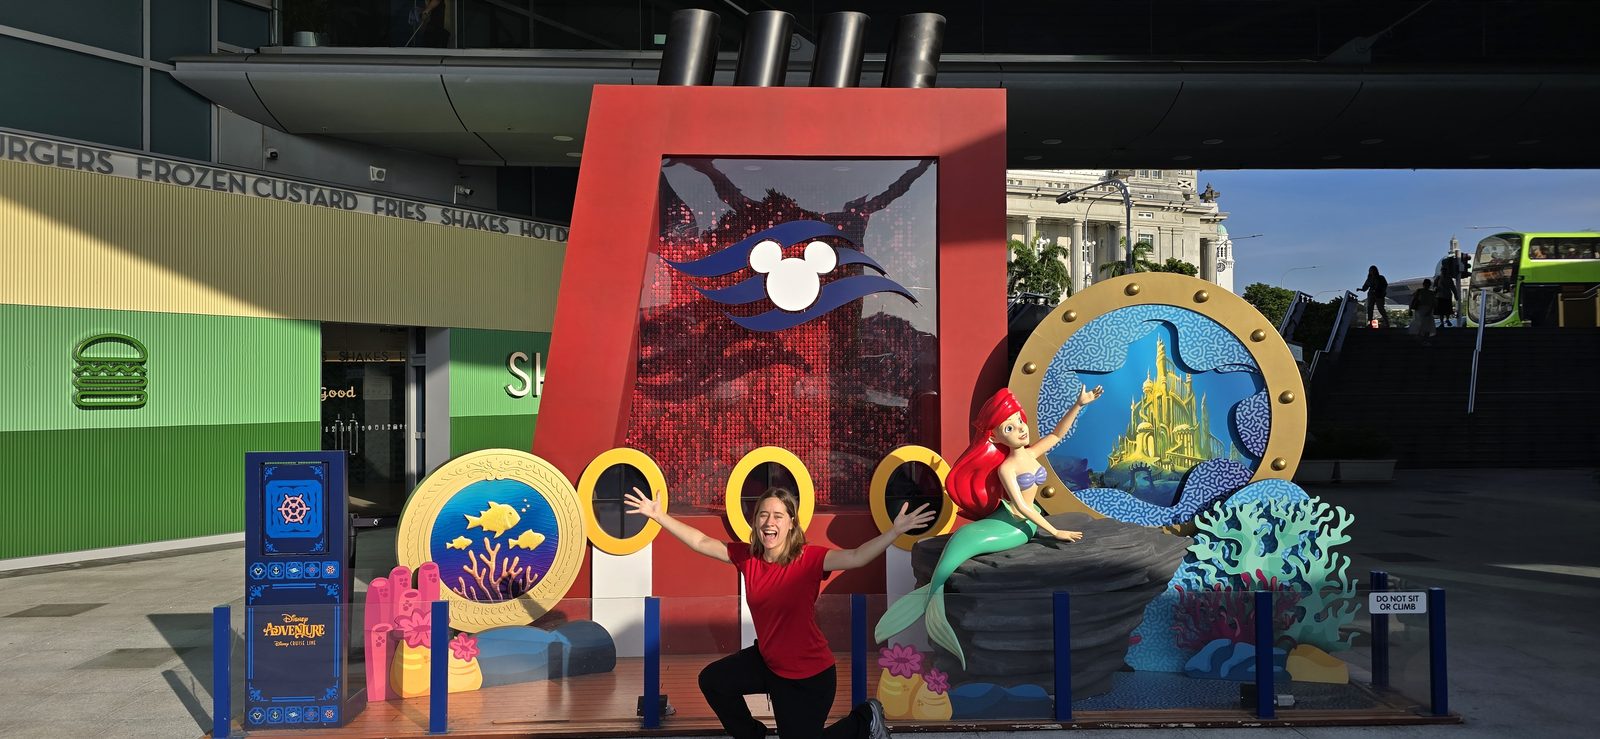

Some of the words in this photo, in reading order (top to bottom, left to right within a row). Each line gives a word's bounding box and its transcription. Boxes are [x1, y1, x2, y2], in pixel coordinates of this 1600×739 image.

[136, 156, 247, 195] FROZEN
[252, 176, 358, 211] CUSTARD
[372, 196, 427, 222] FRIES
[440, 208, 510, 235] SHAKES
[520, 221, 553, 241] HOT
[556, 227, 570, 243] D
[338, 351, 389, 362] SHAKES
[281, 613, 309, 624] Disney
[263, 622, 325, 639] ADVENTURE
[273, 640, 289, 648] Disney
